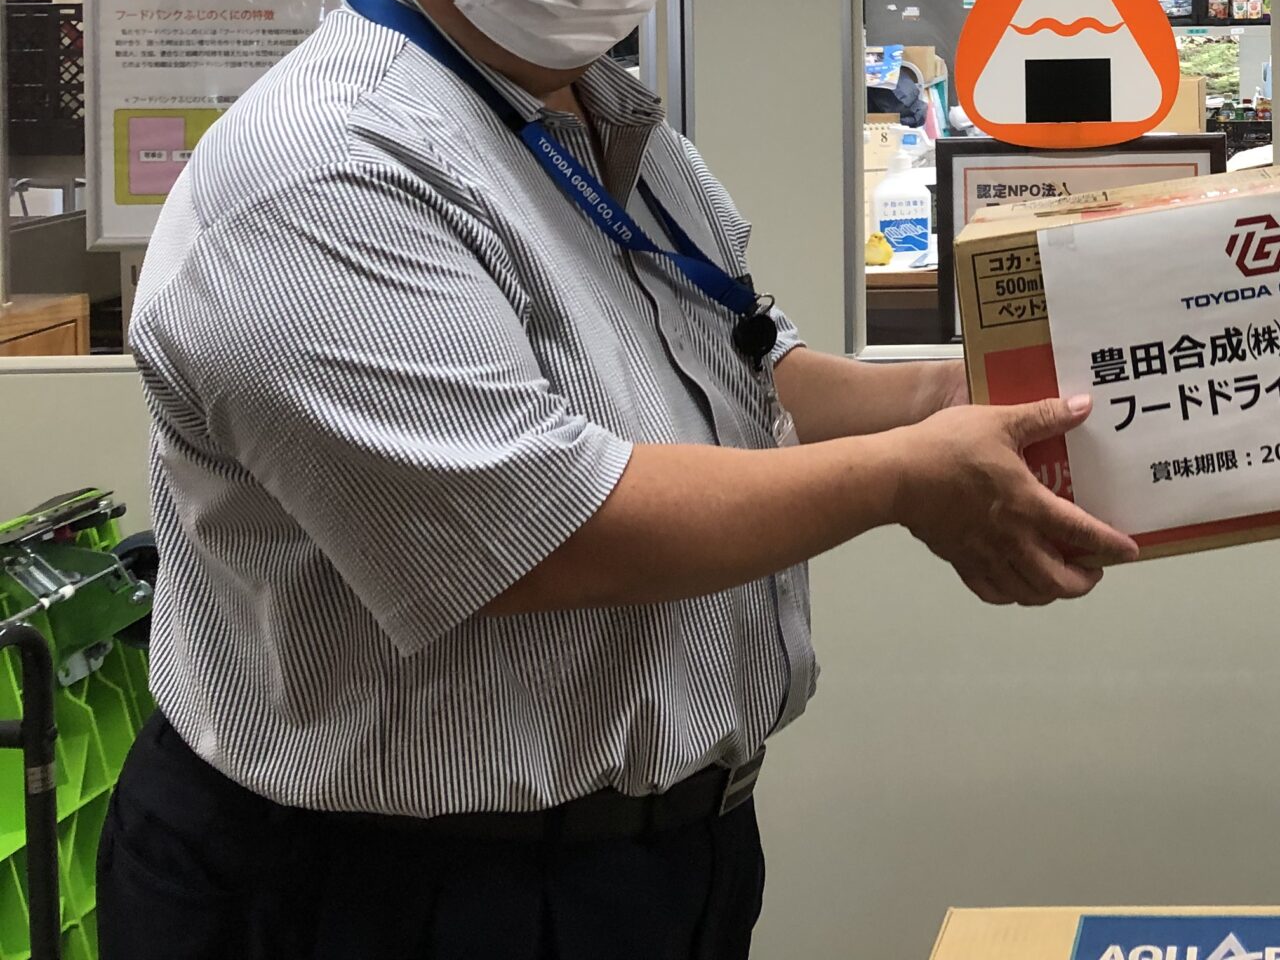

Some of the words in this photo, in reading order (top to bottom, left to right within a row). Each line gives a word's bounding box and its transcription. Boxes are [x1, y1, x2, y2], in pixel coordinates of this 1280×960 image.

[115, 9, 275, 22] フードバンクふじのくにの特徴
[880, 132, 888, 143] 8
[538, 136, 573, 178] TOYODA
[571, 175, 600, 205] GOSEI
[976, 182, 1072, 200] 認定NPO法人
[1181, 285, 1272, 310] TOYODA
